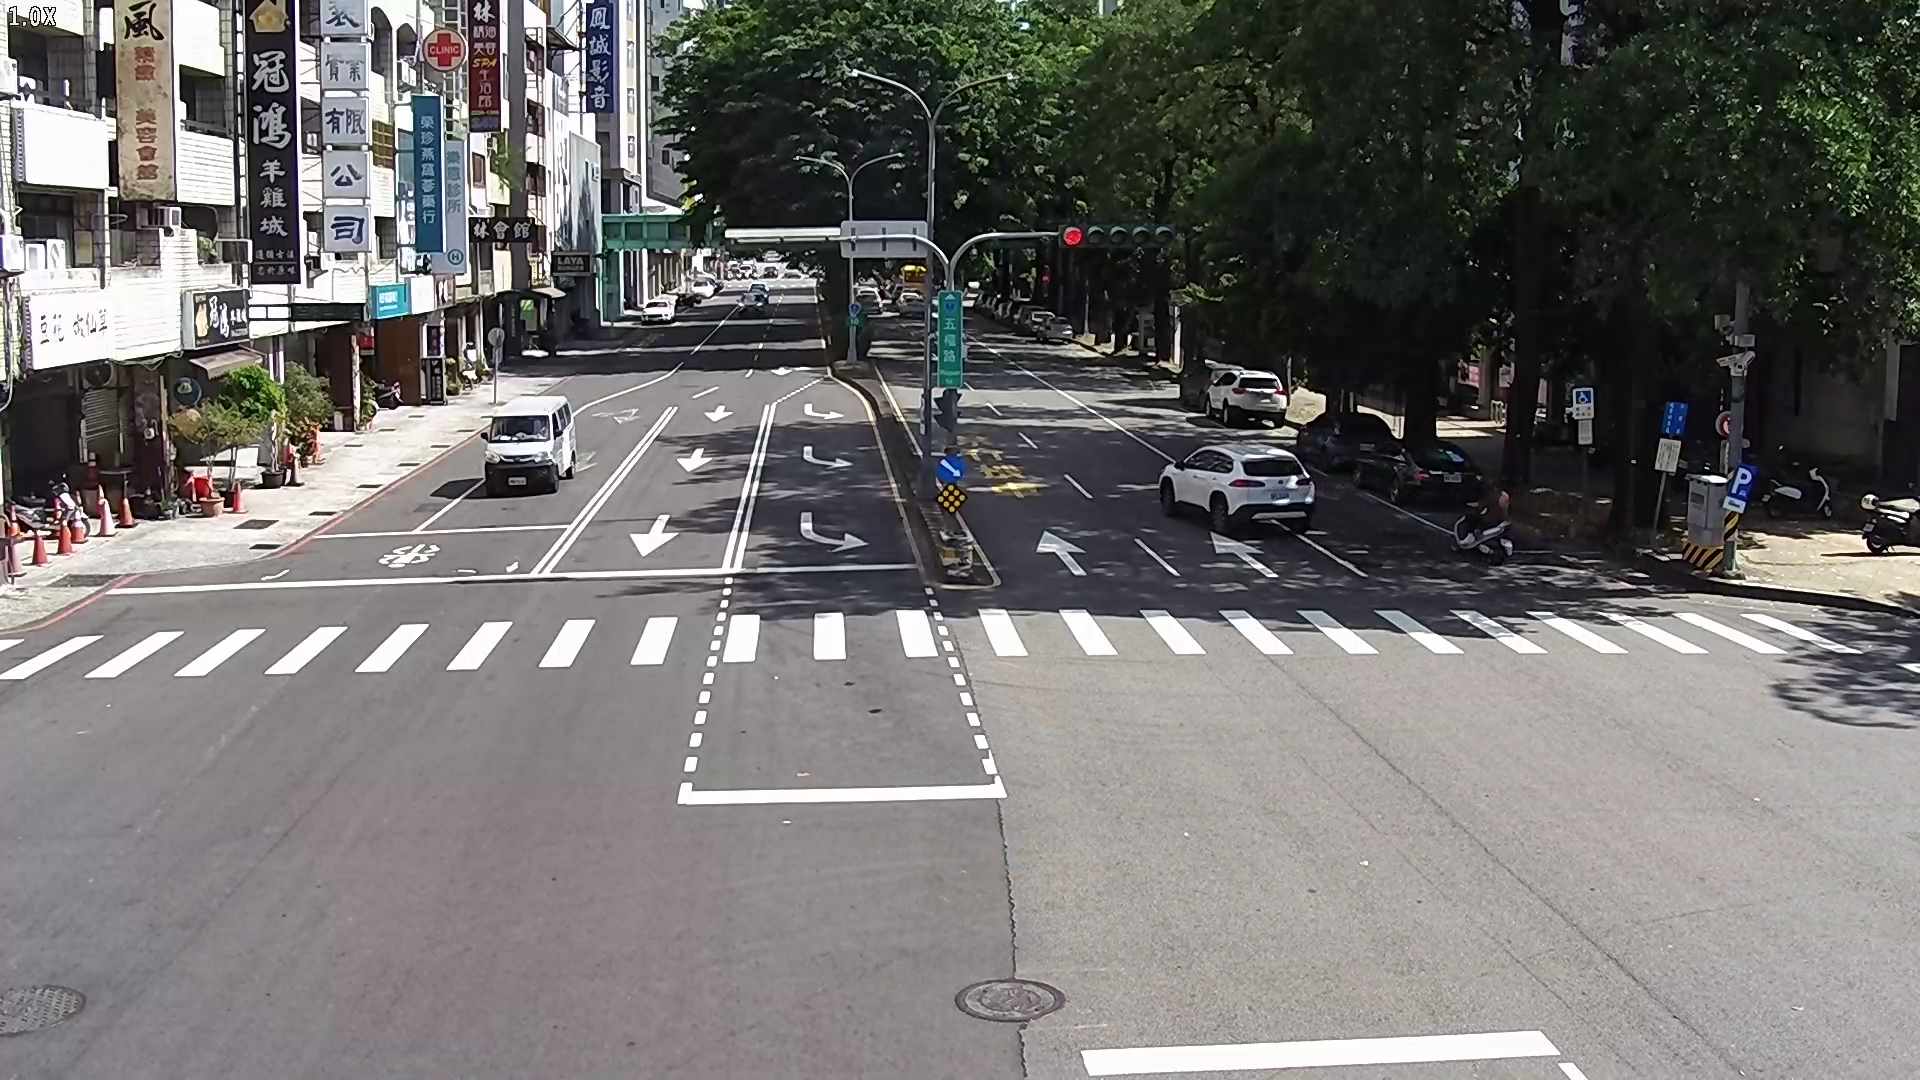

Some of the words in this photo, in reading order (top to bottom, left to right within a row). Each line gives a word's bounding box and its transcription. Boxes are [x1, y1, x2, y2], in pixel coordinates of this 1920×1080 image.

[124, 1, 165, 41] 風
[429, 45, 460, 55] CLINIC
[472, 58, 497, 69] SPA
[251, 50, 293, 149] 冠鴻
[473, 220, 531, 240] 林會館
[557, 256, 584, 265] LAYA
[1732, 467, 1752, 494] P
